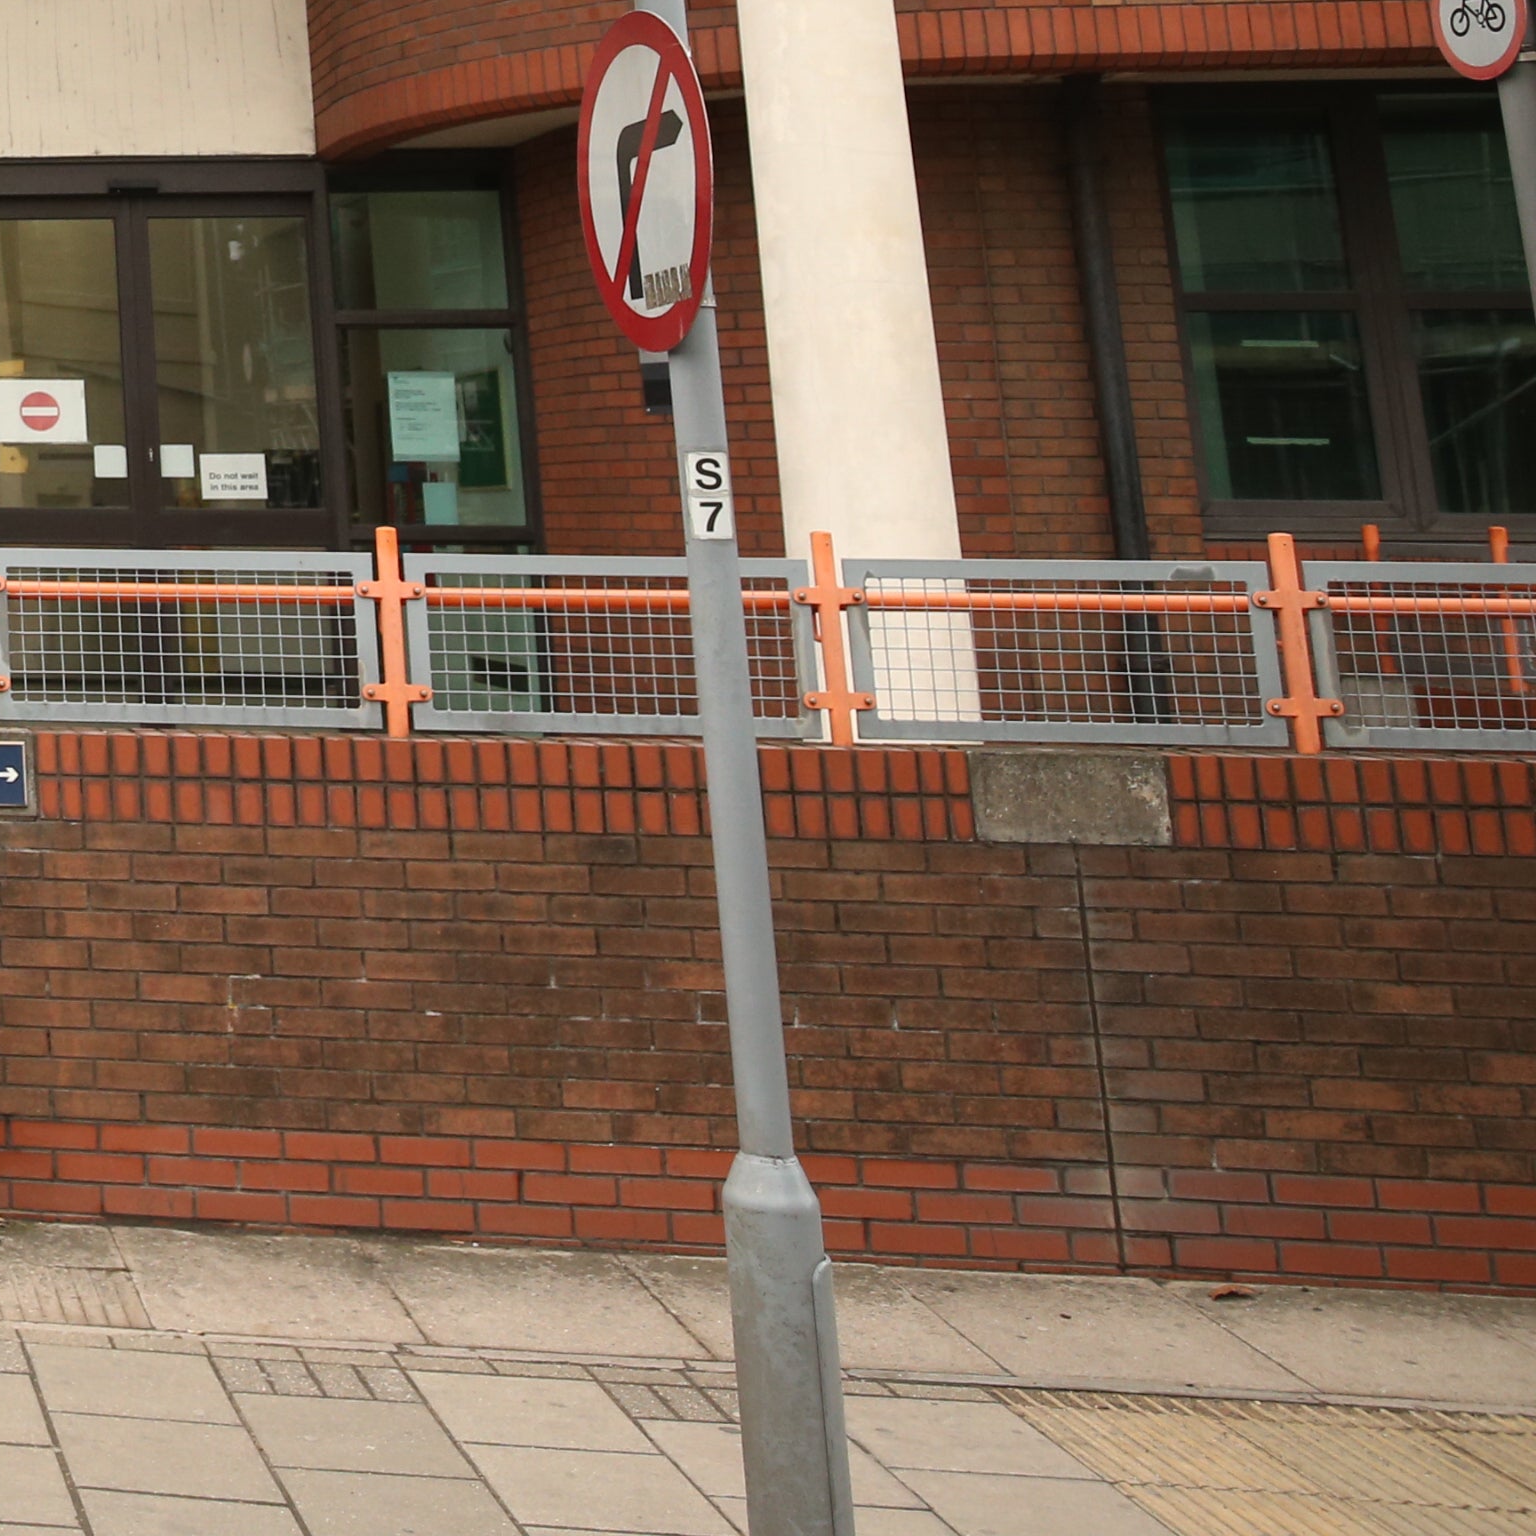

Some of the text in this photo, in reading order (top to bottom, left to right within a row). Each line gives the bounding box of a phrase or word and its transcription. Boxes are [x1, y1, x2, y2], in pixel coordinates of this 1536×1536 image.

[209, 472, 259, 480] Do not wait
[695, 457, 723, 490] S
[699, 502, 723, 532] 7
